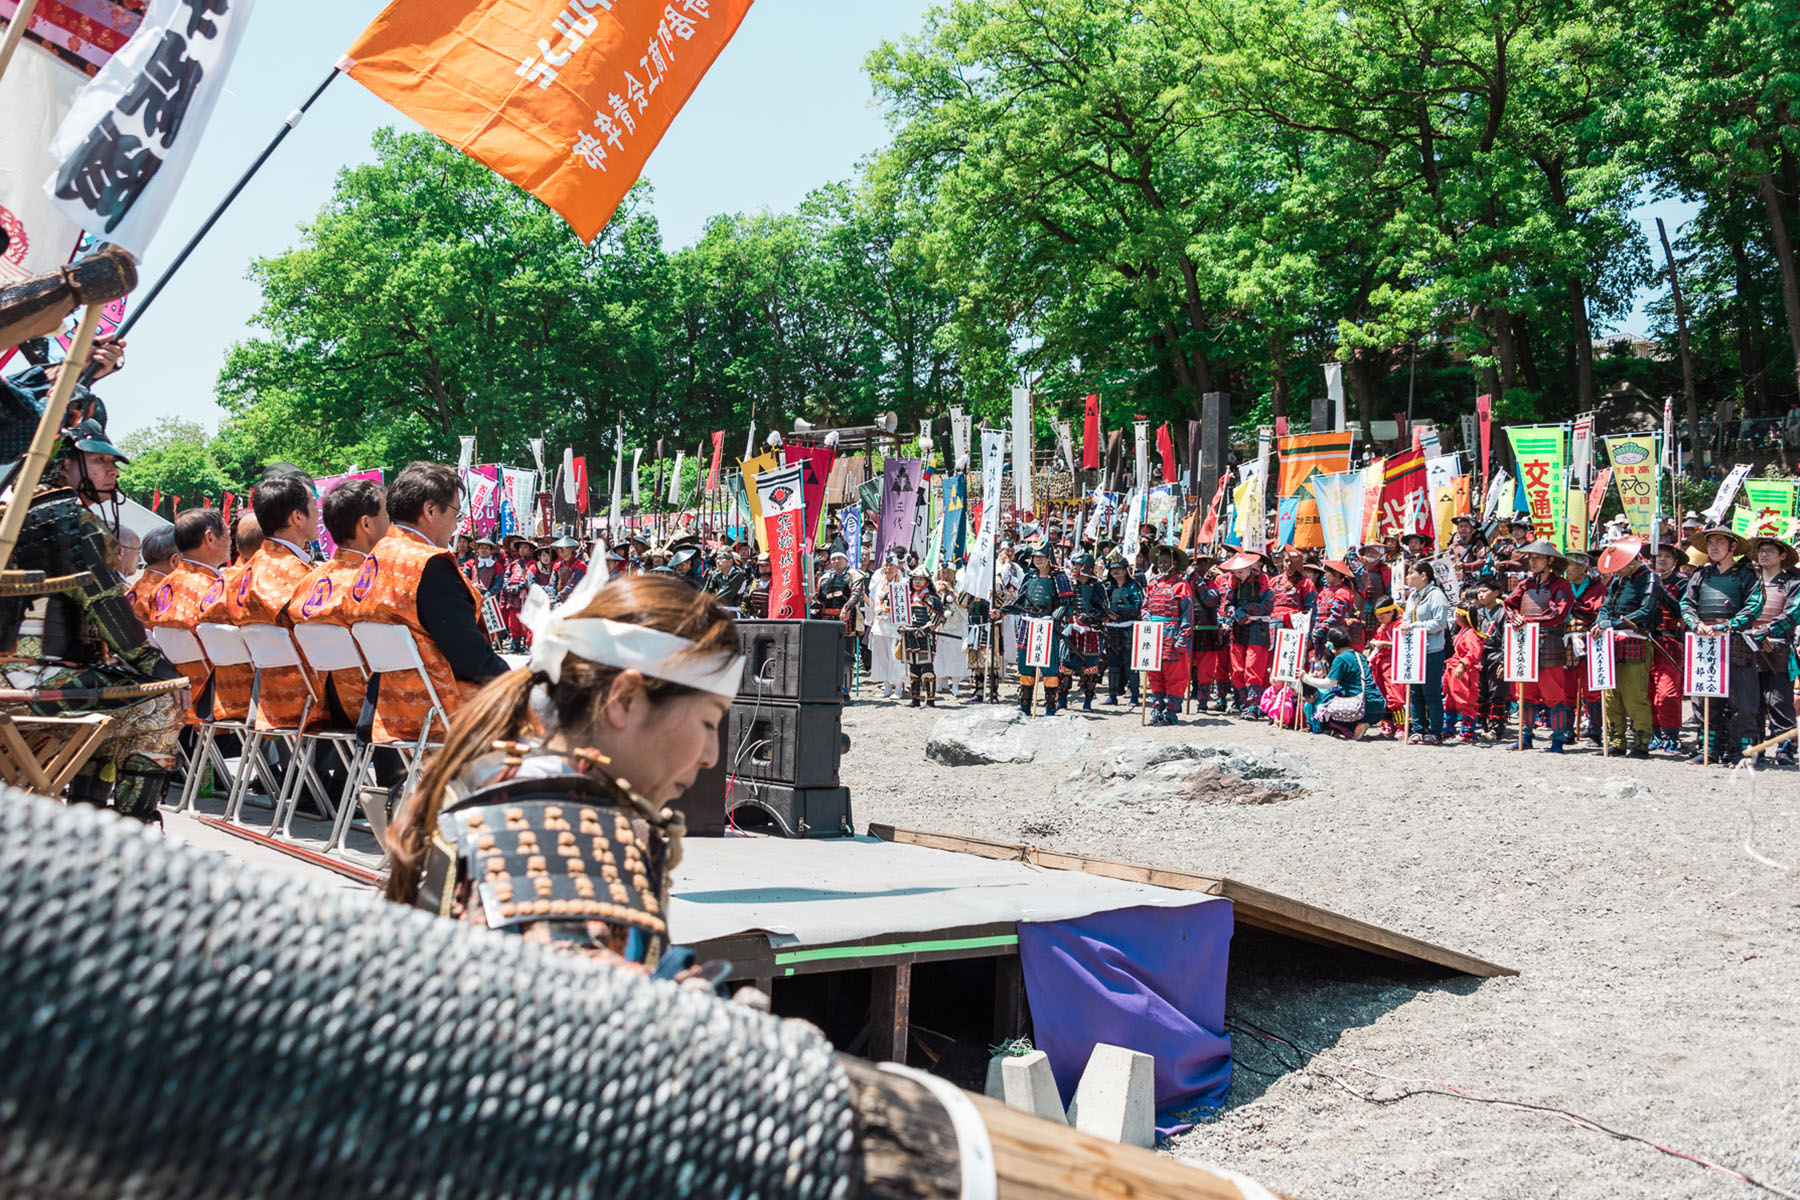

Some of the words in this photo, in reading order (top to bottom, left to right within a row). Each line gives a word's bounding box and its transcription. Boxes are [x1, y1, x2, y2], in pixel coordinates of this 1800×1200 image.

[776, 513, 795, 618] 箕輪城まつり
[899, 584, 907, 624] 八王子城
[1695, 637, 1706, 693] 青年部隊
[1706, 637, 1717, 693] 寄居町商工会
